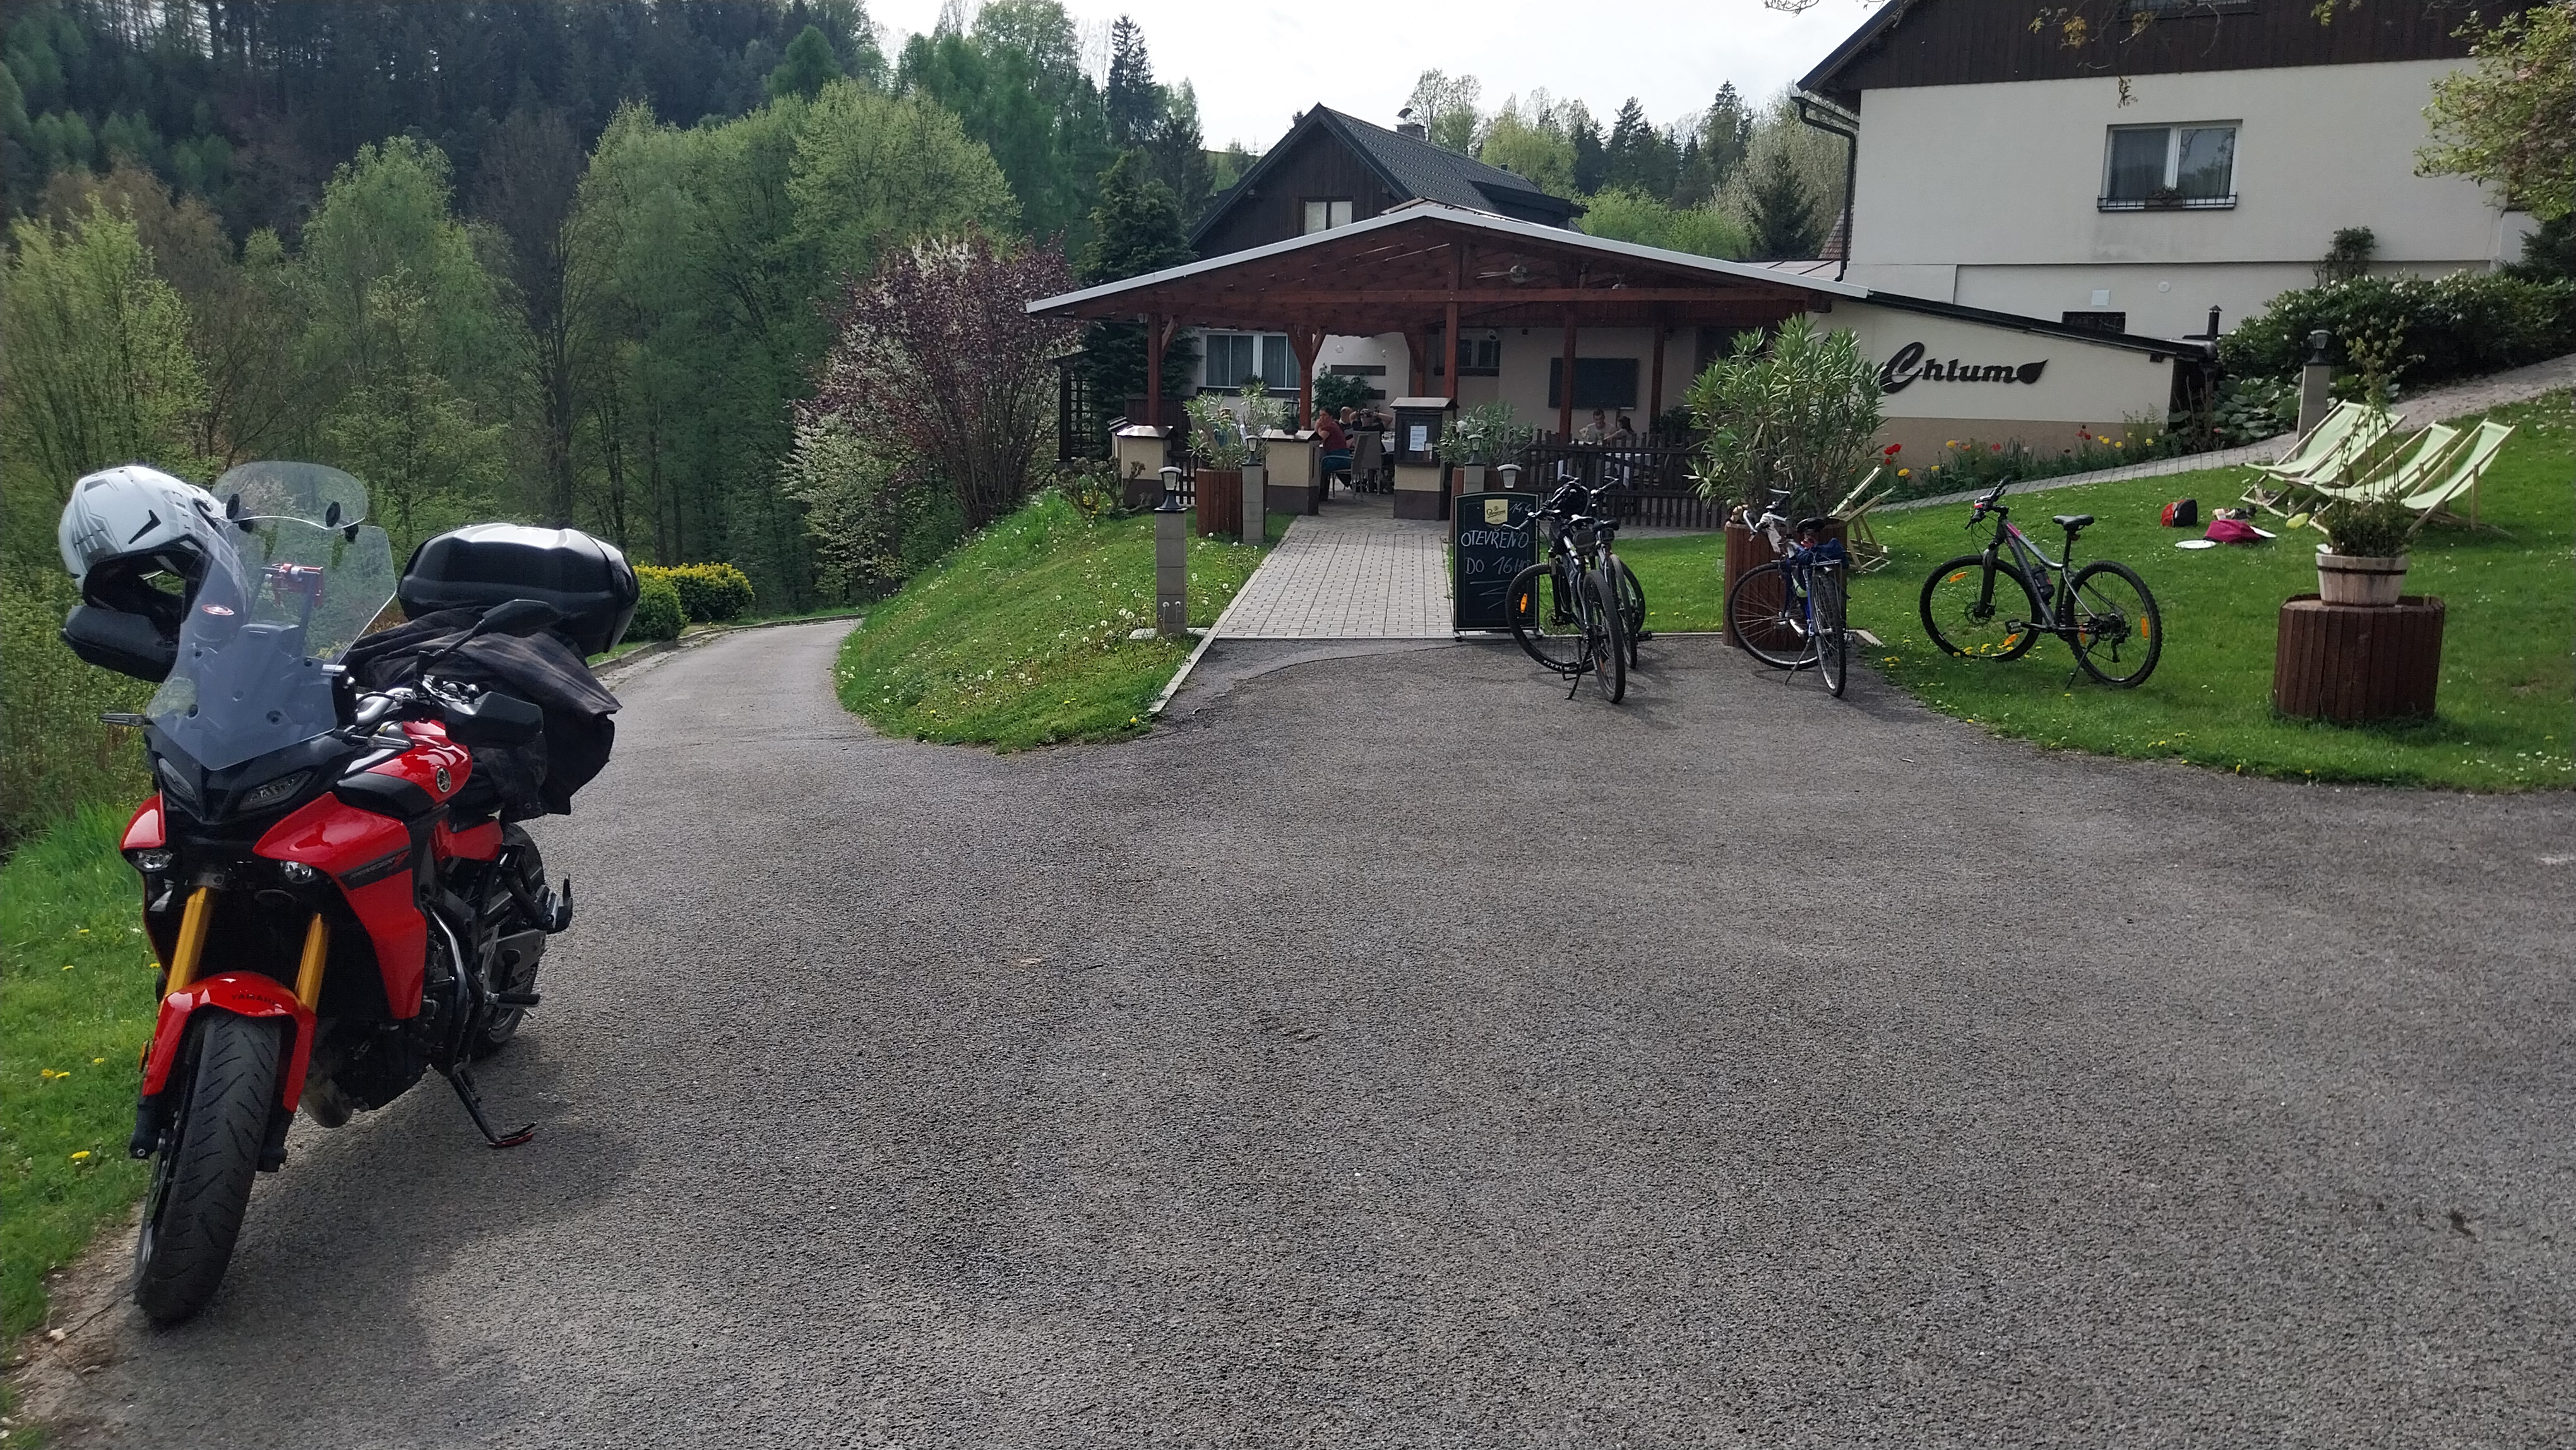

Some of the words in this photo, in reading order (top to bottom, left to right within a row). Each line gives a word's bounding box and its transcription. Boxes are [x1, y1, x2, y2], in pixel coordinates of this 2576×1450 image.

[1879, 342, 2018, 393] Chlum
[1460, 529, 1529, 549] OTEVŘENO
[1465, 557, 1484, 574] DO
